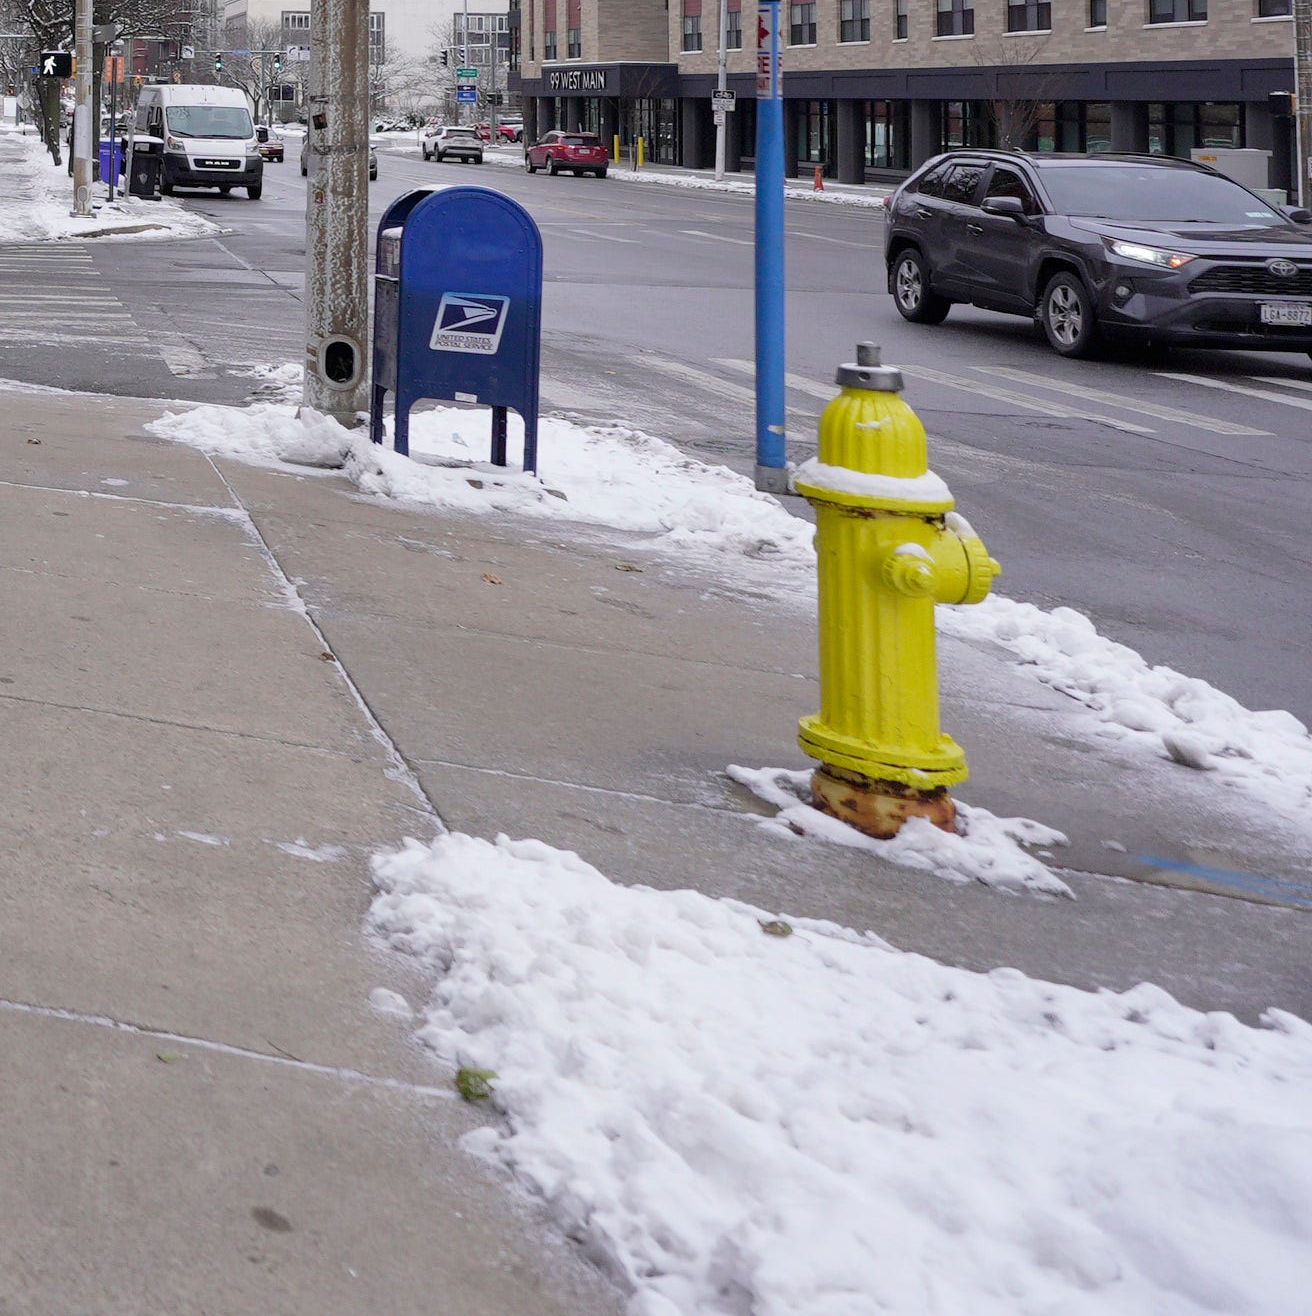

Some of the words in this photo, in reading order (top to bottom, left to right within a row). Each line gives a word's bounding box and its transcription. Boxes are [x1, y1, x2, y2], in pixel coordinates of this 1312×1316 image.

[550, 72, 560, 89] 99
[560, 71, 581, 89] WEST
[583, 71, 605, 89] MAIN
[437, 334, 464, 342] UNITED
[465, 336, 491, 344] STATES
[435, 340, 461, 348] POSTAL
[463, 342, 493, 351] SERVICE
